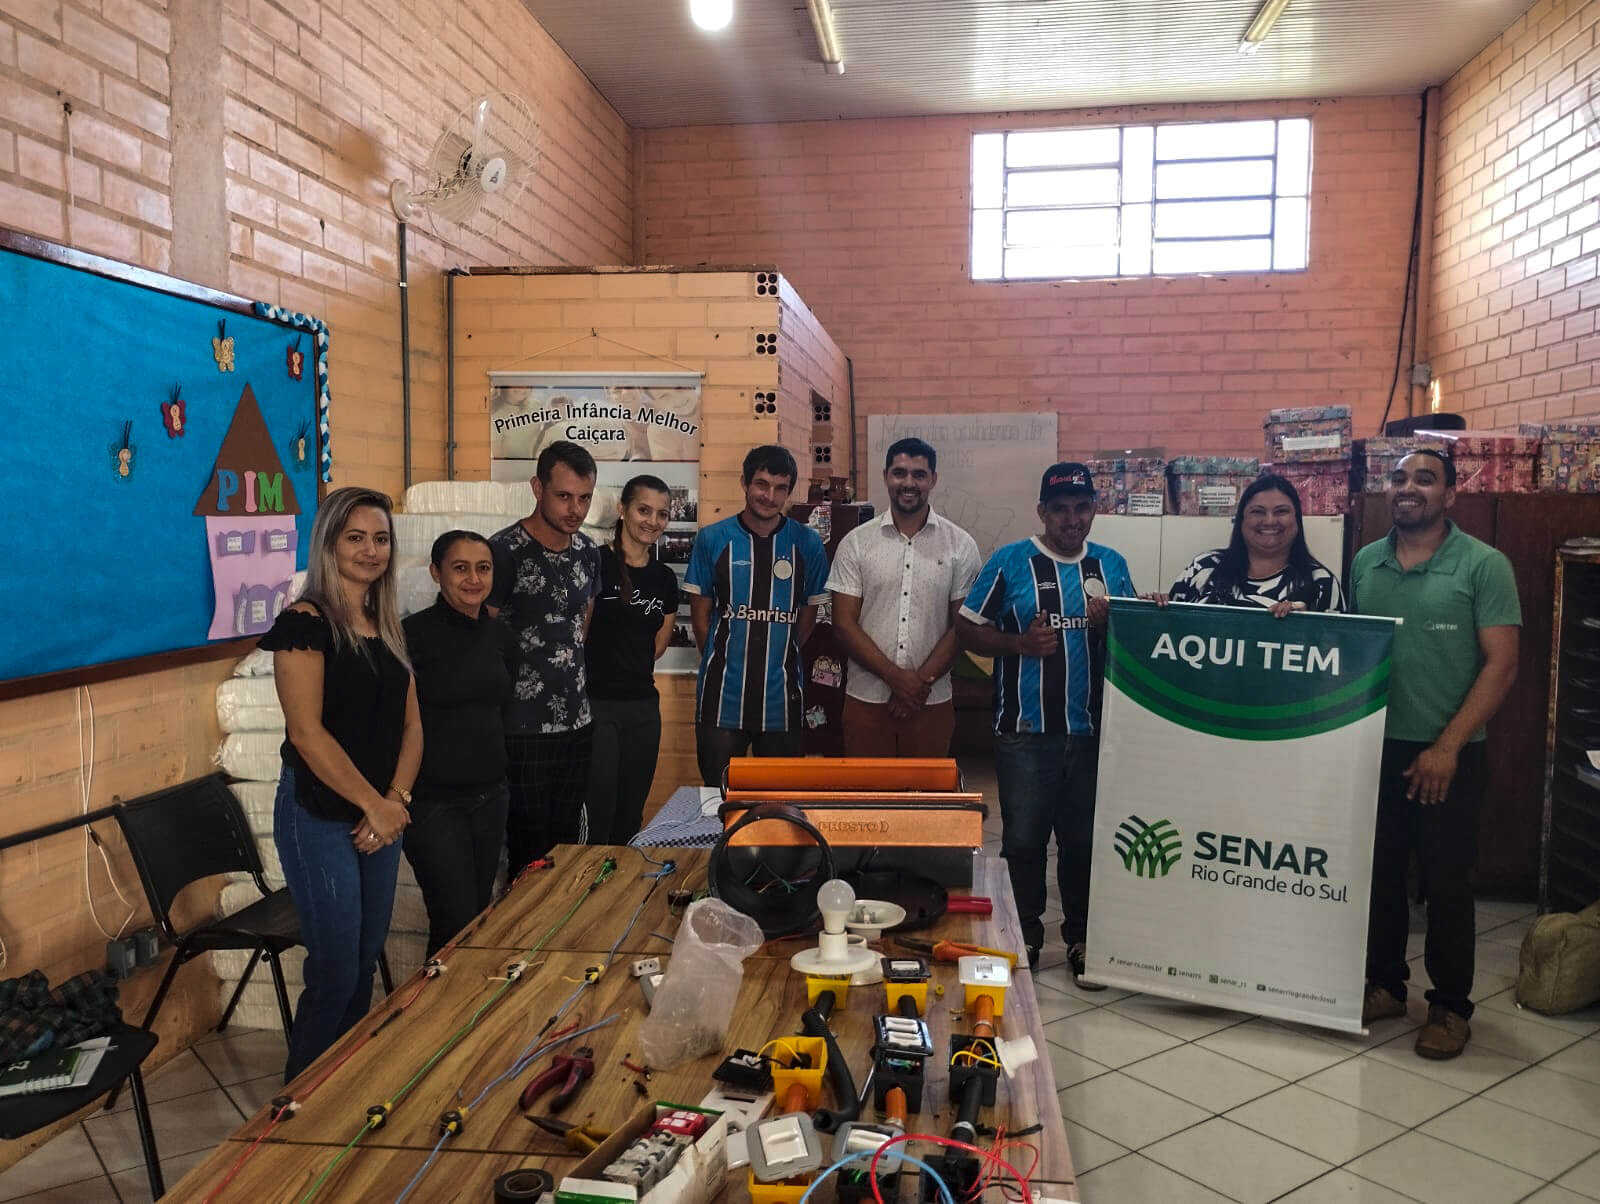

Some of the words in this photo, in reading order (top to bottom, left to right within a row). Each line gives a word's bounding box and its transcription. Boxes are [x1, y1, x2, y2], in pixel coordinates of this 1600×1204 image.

[494, 406, 562, 434] Primeira
[566, 402, 632, 420] Infância
[638, 407, 698, 435] Melhor
[565, 425, 626, 444] Caiçara
[216, 469, 285, 512] PIM
[736, 604, 798, 624] Banrisul
[1049, 613, 1089, 630] Banr
[1150, 632, 1245, 670] AQUI
[1257, 641, 1340, 676] TEM
[1193, 831, 1329, 878] SENAR
[1191, 864, 1219, 882] Rio
[1223, 869, 1288, 893] Grande
[1291, 879, 1316, 897] do
[1319, 883, 1348, 903] Sul
